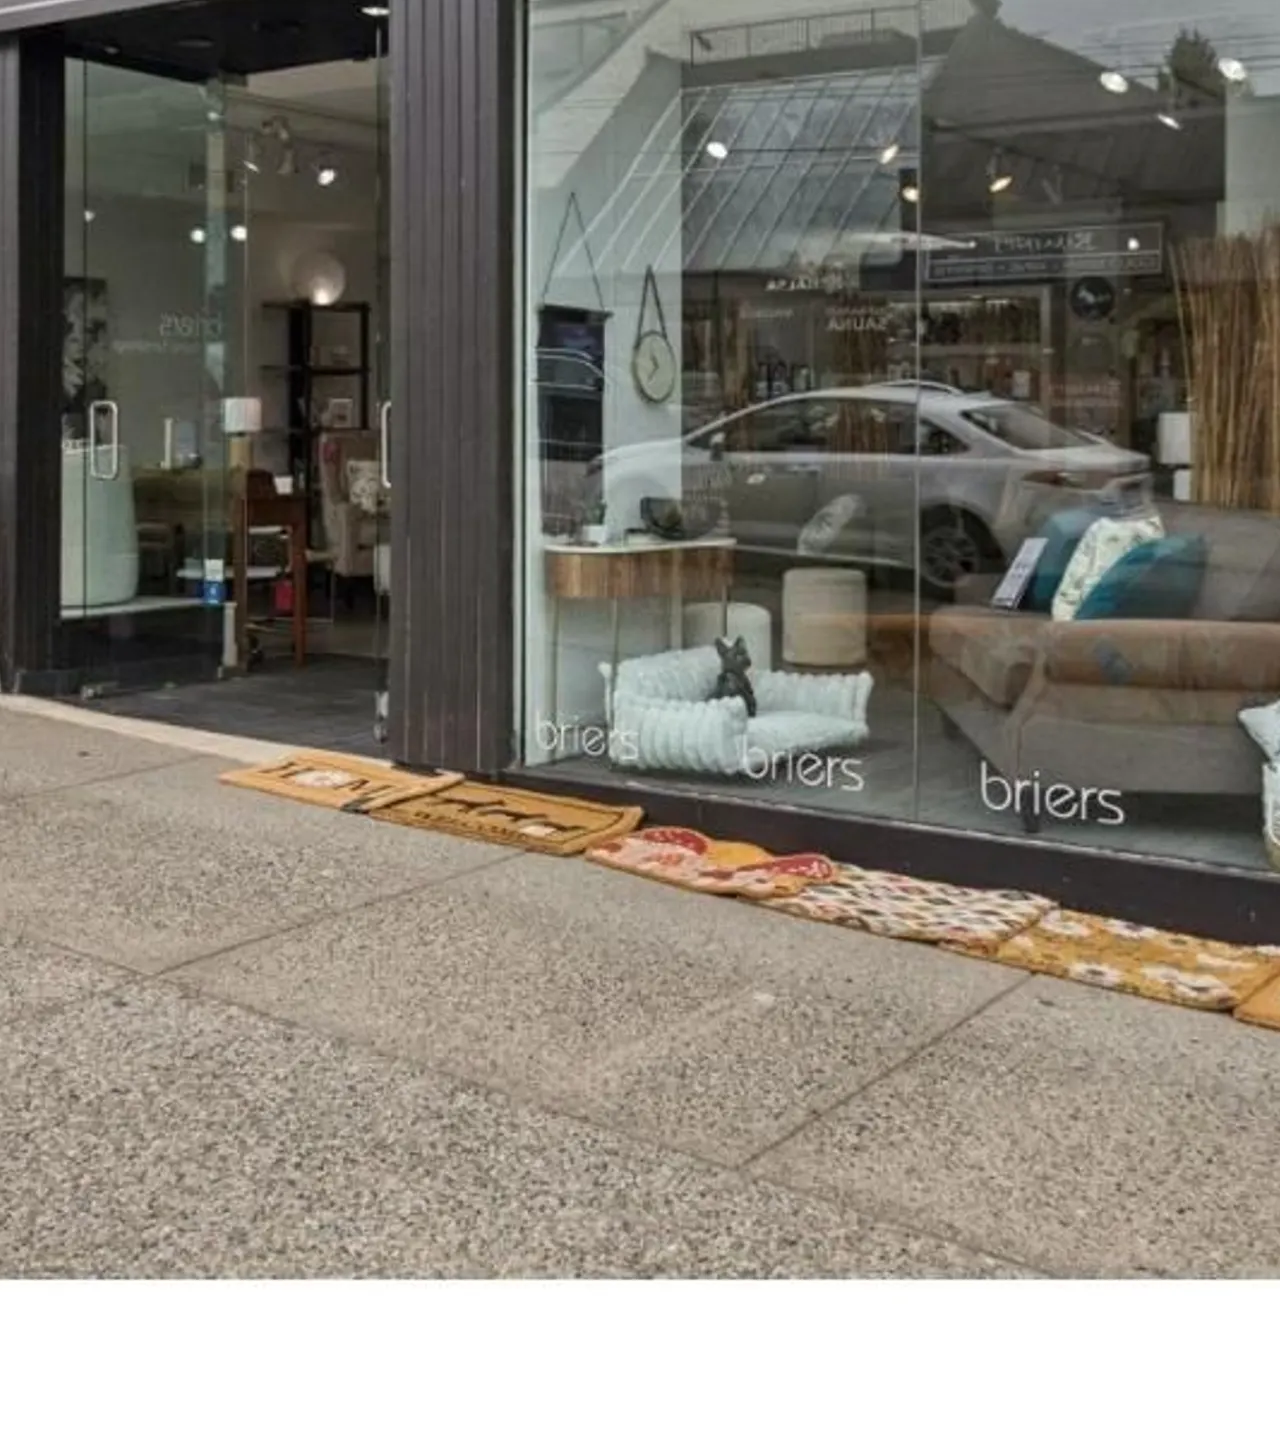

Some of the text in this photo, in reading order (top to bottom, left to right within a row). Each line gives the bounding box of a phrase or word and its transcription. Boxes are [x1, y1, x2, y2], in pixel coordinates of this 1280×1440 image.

[534, 717, 640, 761] briers
[741, 734, 865, 792] briers
[980, 760, 1127, 826] briers
